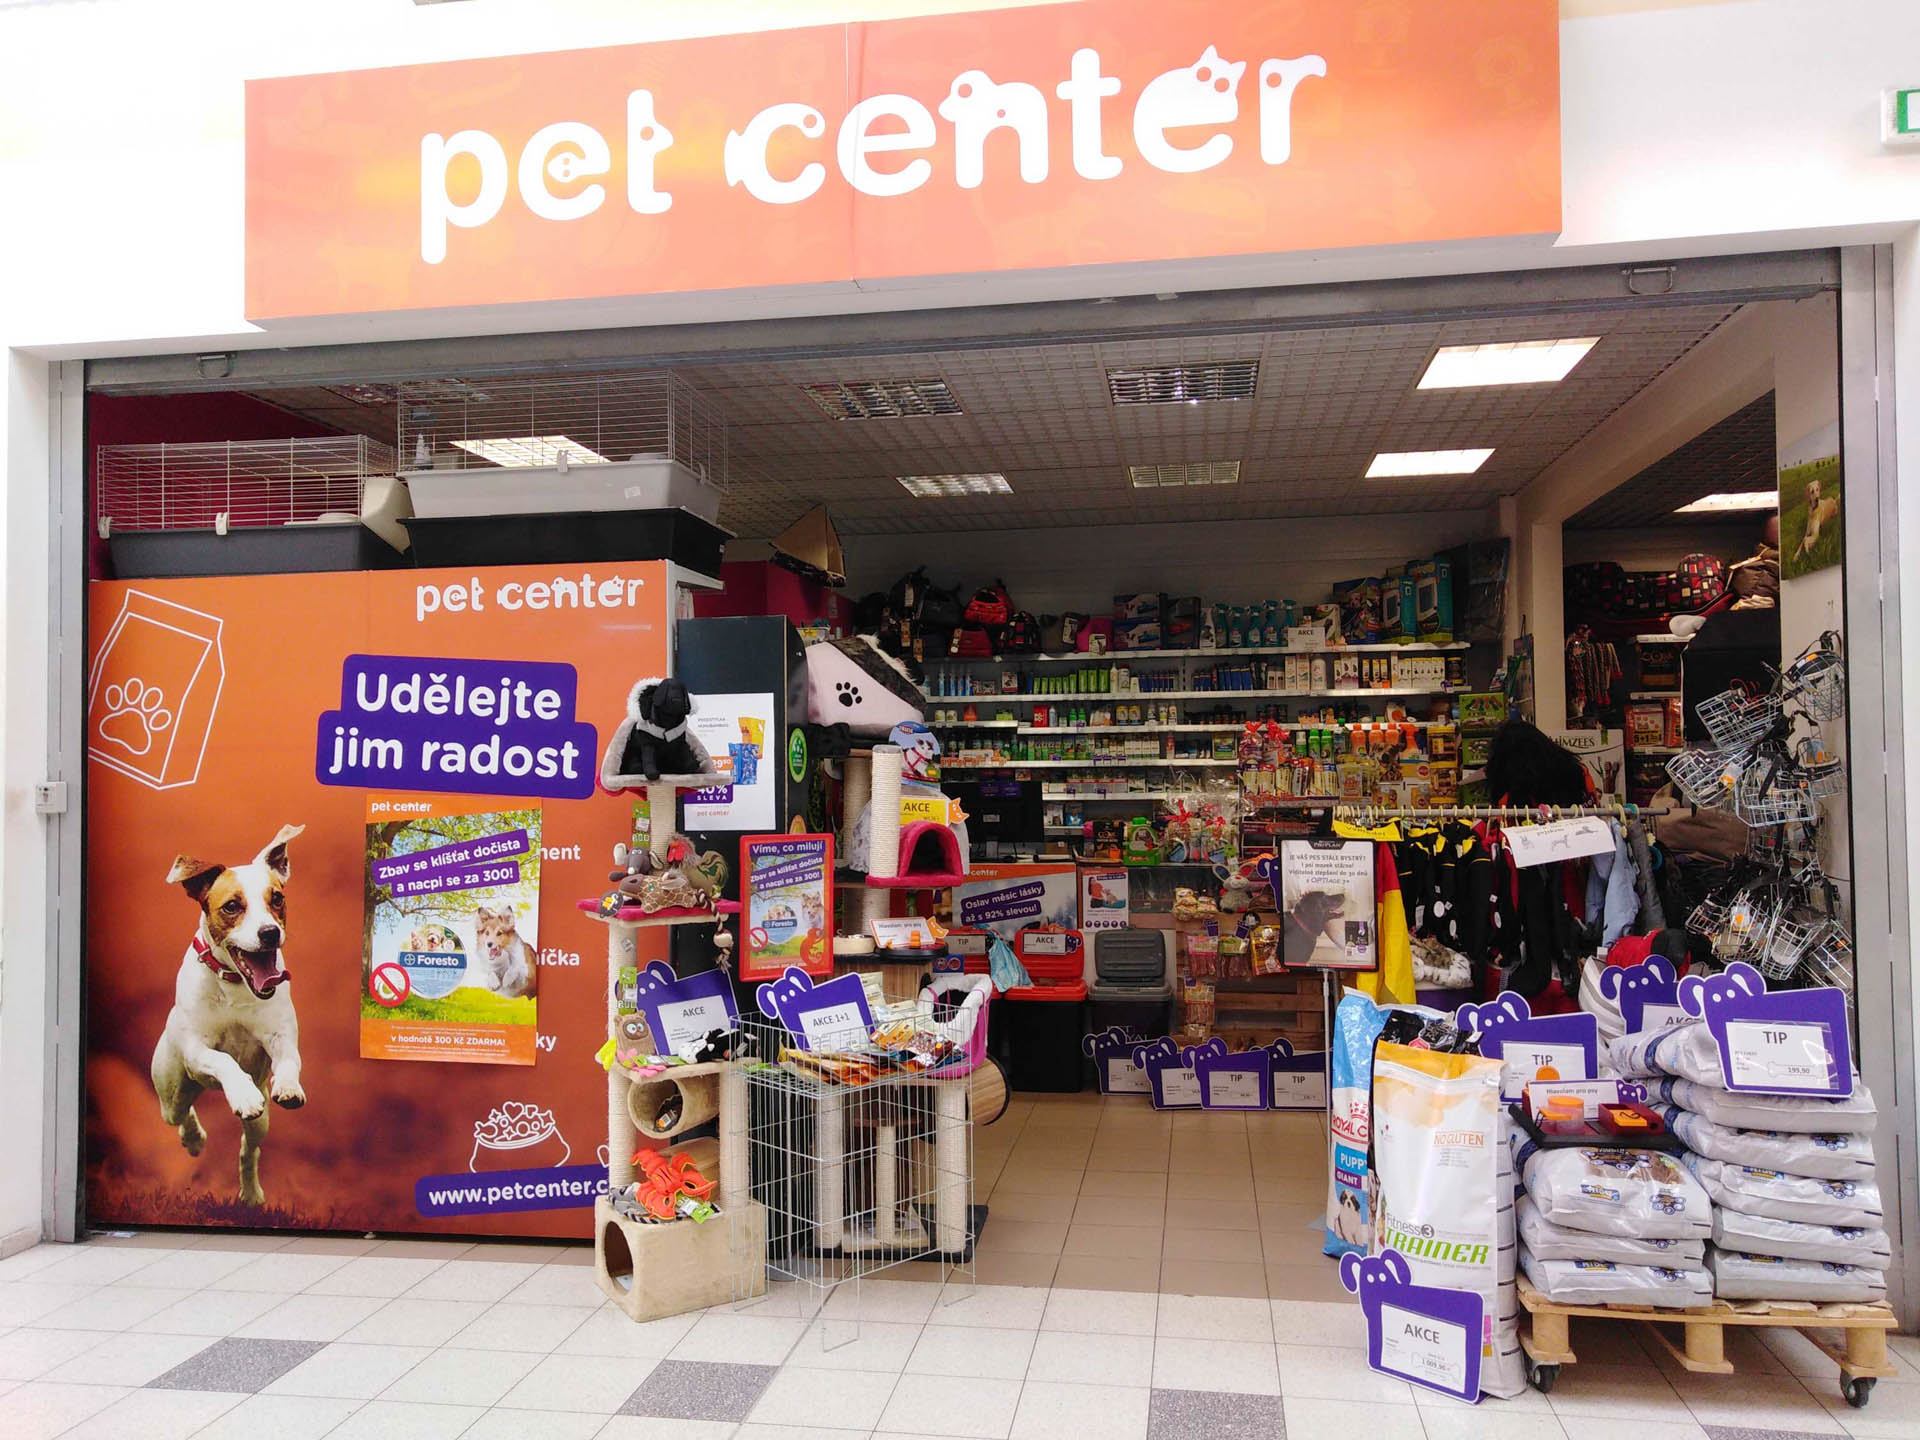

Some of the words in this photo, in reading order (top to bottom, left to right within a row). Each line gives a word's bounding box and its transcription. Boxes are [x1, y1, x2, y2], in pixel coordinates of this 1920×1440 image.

[420, 88, 672, 264] pet
[723, 44, 1326, 203] center
[416, 577, 484, 621] pet
[497, 573, 644, 610] center
[356, 672, 561, 725] Udělejte
[329, 726, 403, 774] jim
[421, 734, 580, 779] radost
[371, 801, 390, 813] pet
[393, 801, 432, 812] center
[903, 802, 930, 812] AKCE
[752, 844, 780, 854] Víme,
[797, 842, 823, 851] milují
[379, 863, 409, 879] Zbav
[413, 860, 428, 872] se
[431, 850, 470, 868] klíšťat
[473, 839, 520, 858] dočista
[396, 883, 405, 893] a
[408, 876, 443, 891] nacpi
[446, 876, 460, 886] se
[464, 873, 480, 884] za
[483, 867, 514, 881] 300!
[966, 897, 990, 910] Oslav
[992, 891, 1017, 904] měsíc
[1019, 885, 1043, 898] lásky
[965, 911, 976, 922] až
[985, 909, 1004, 920] 92%
[1006, 904, 1038, 916] slevou!
[1036, 936, 1055, 944] AKCE
[417, 955, 459, 967] Foresto
[682, 1006, 706, 1018] AKCE
[813, 1015, 833, 1027] AKCE
[835, 1013, 850, 1023] 1+1
[398, 1034, 432, 1044] hodnotě
[435, 1036, 452, 1044] 300
[454, 1036, 464, 1045] Kč
[466, 1037, 506, 1046] ZDARMA!
[1763, 1031, 1788, 1044] TIP
[1532, 1054, 1552, 1066] TIP
[1230, 1074, 1244, 1082] TIP
[1292, 1076, 1306, 1084] TIP
[1336, 1172, 1358, 1186] GIANT
[1386, 1212, 1421, 1234] Fitness
[1386, 1227, 1489, 1265] TRAINER
[1404, 1324, 1440, 1344] AKCE
